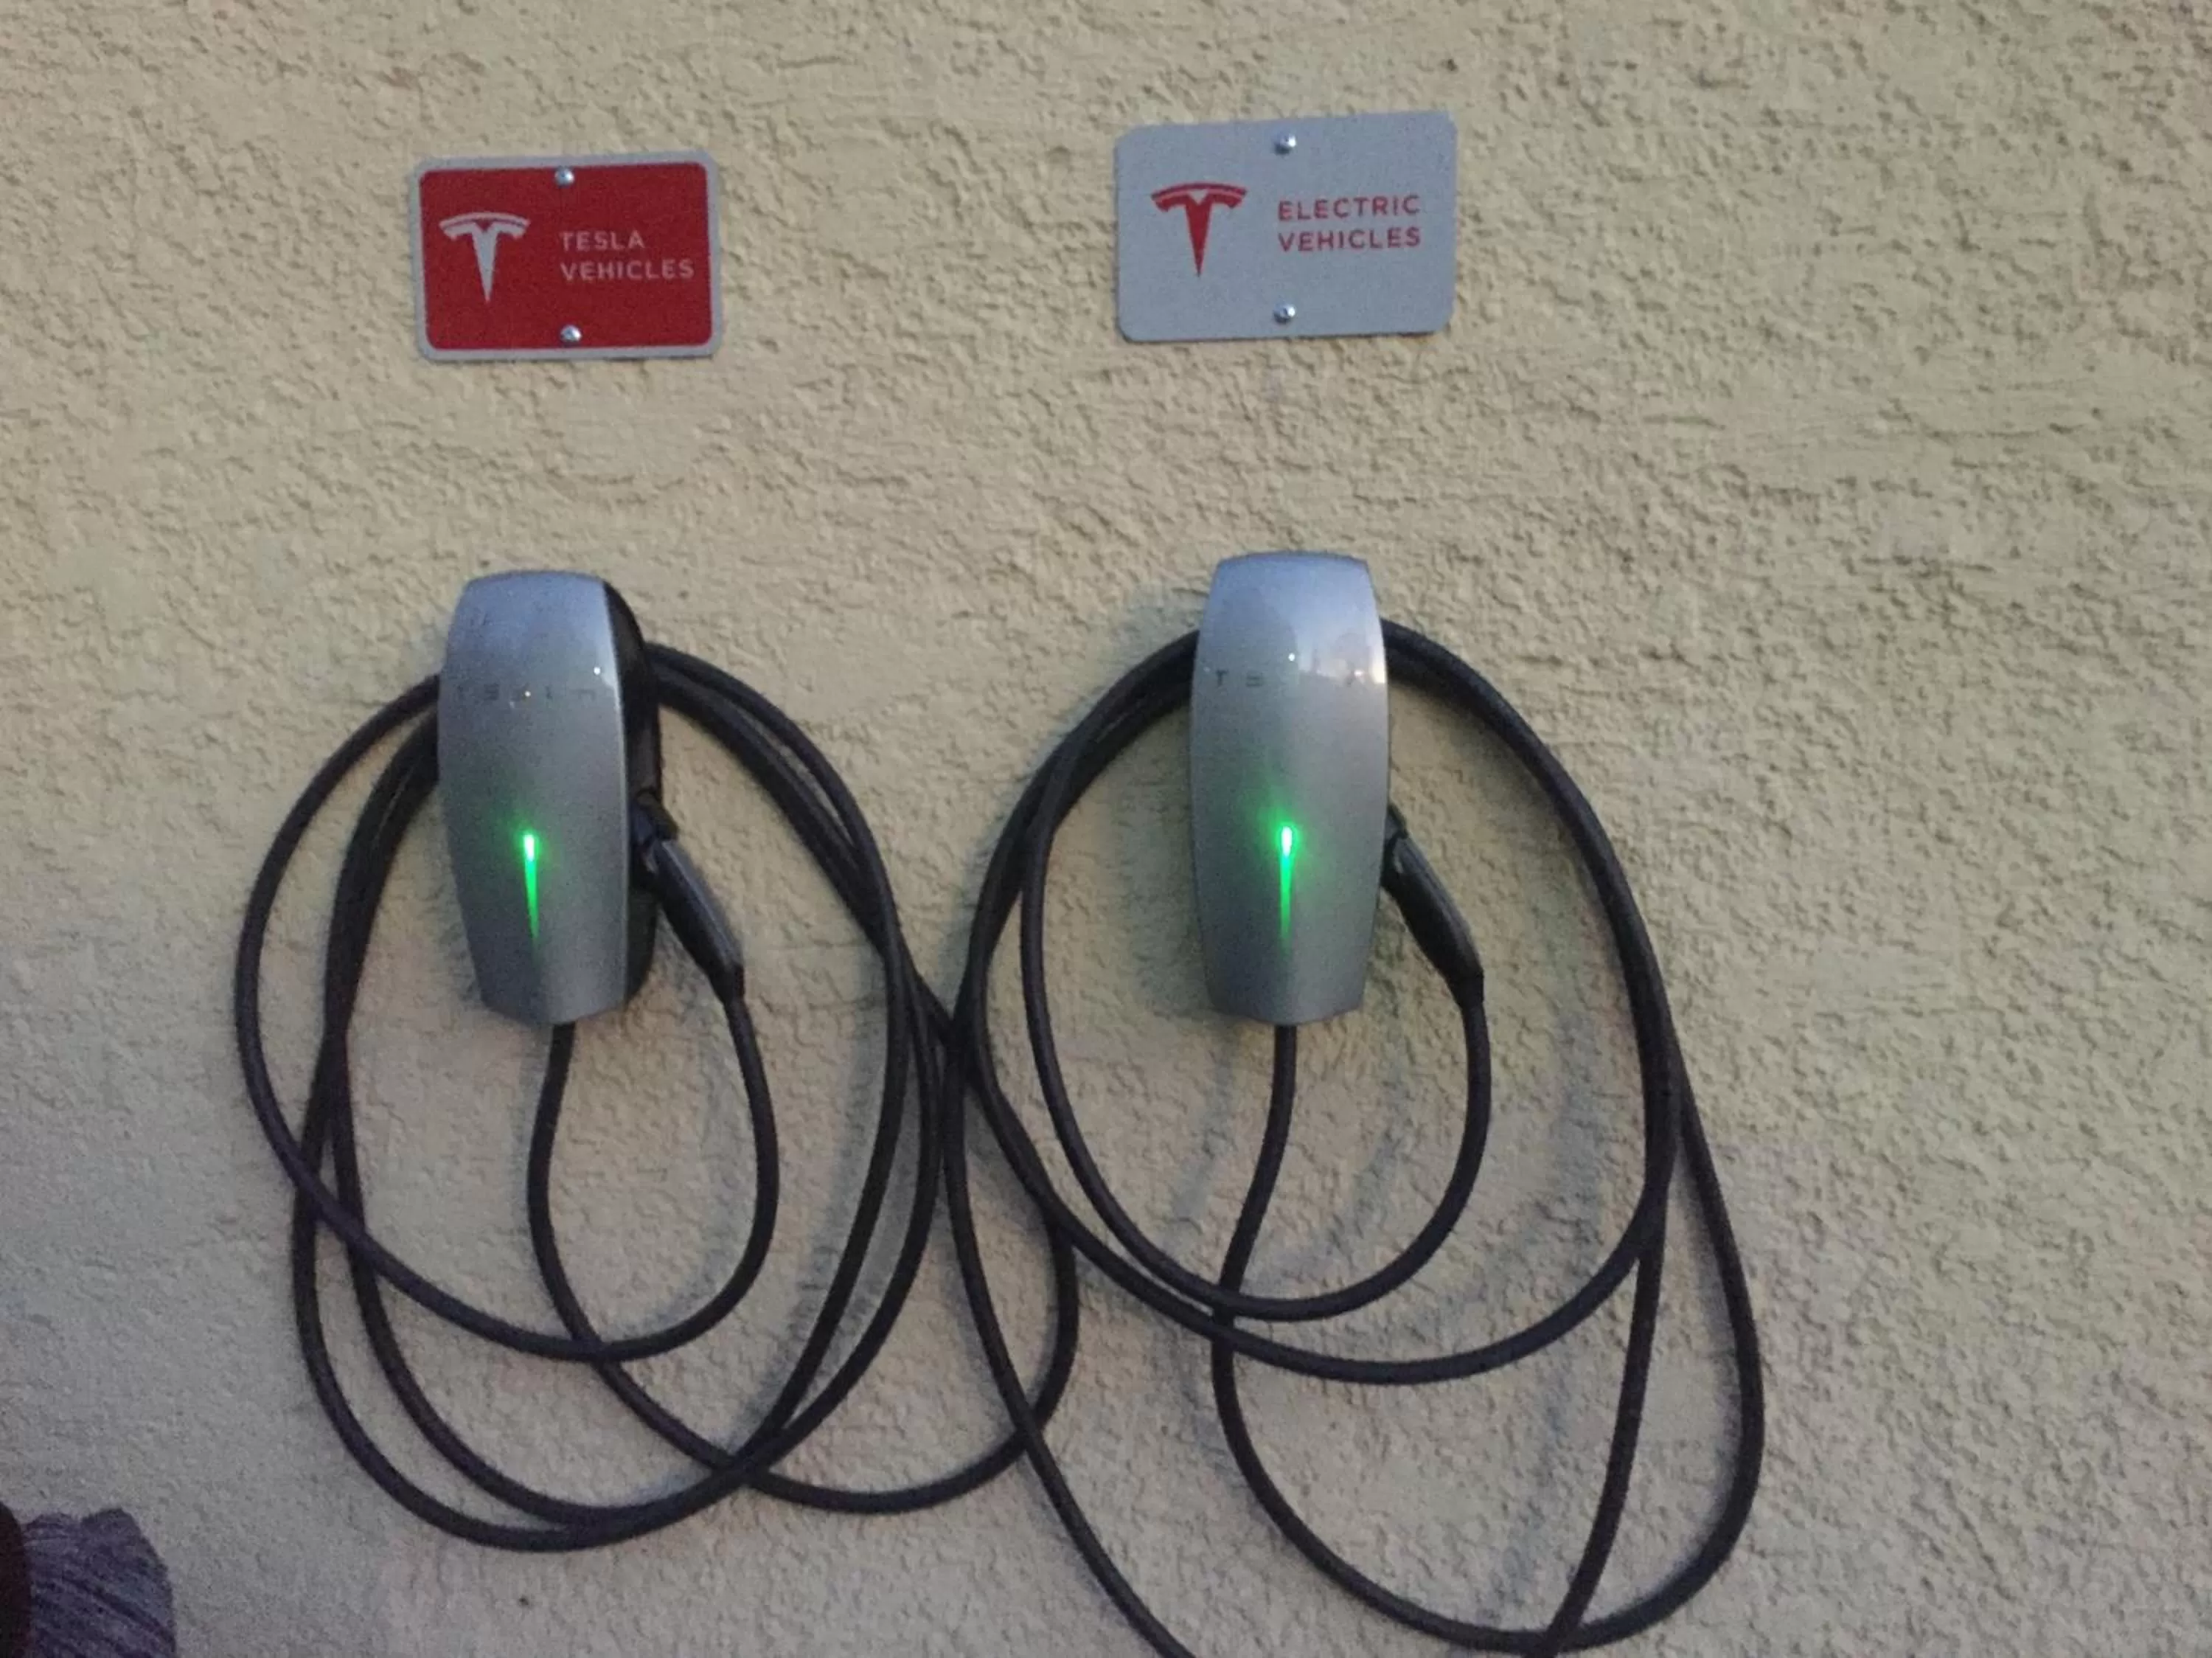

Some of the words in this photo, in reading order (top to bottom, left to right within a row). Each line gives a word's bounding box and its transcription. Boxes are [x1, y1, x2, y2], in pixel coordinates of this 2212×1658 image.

[1278, 194, 1421, 221] ELECTRIC
[560, 230, 645, 252] TESLA
[1278, 226, 1421, 252] VEHICLES
[560, 259, 695, 282] VEHICLES
